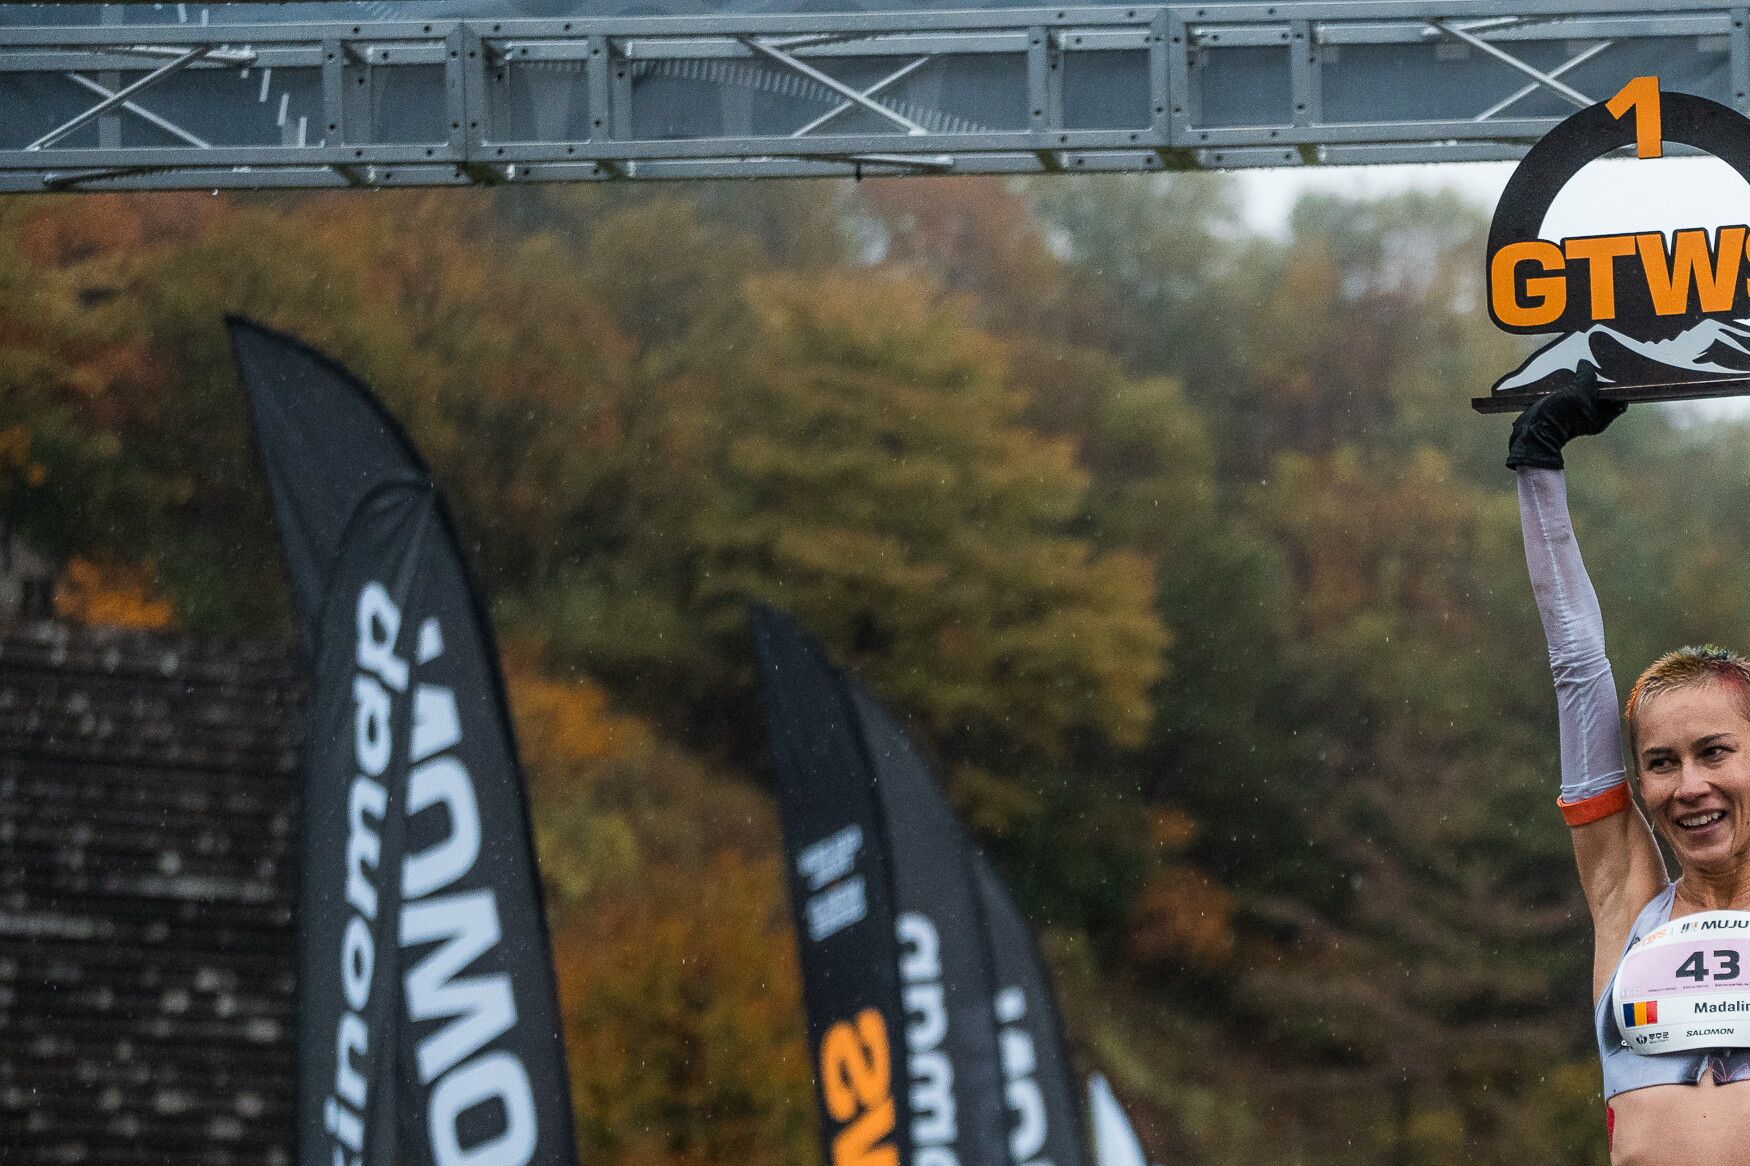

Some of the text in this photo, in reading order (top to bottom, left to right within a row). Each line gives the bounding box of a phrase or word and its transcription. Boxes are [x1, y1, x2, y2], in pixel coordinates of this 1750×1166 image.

[1604, 75, 1663, 160] 1
[1701, 919, 1750, 930] MUJU
[1675, 949, 1741, 982] 43
[1686, 1028, 1735, 1037] SALOMON
